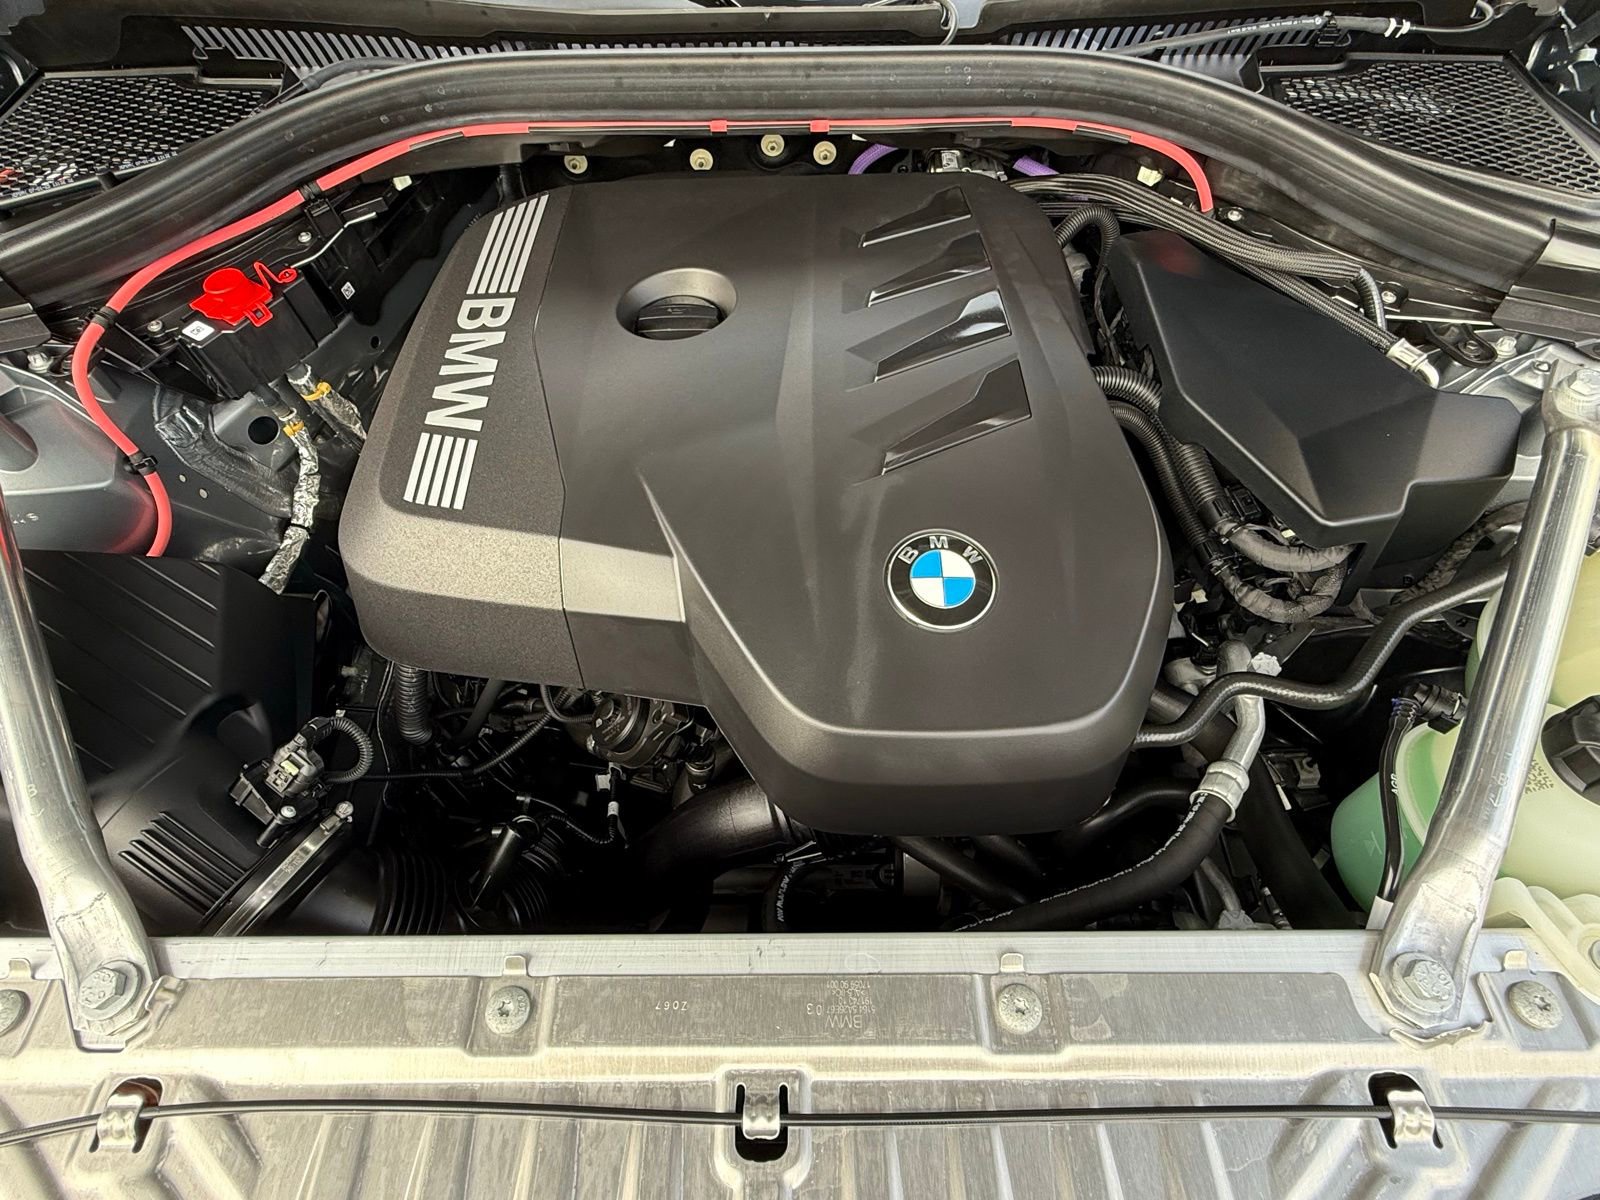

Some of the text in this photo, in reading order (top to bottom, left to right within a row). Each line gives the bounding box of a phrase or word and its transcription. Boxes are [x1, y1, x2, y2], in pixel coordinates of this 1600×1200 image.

[424, 297, 516, 432] BMW
[898, 535, 983, 564] BMW
[825, 1015, 862, 1029] BMW
